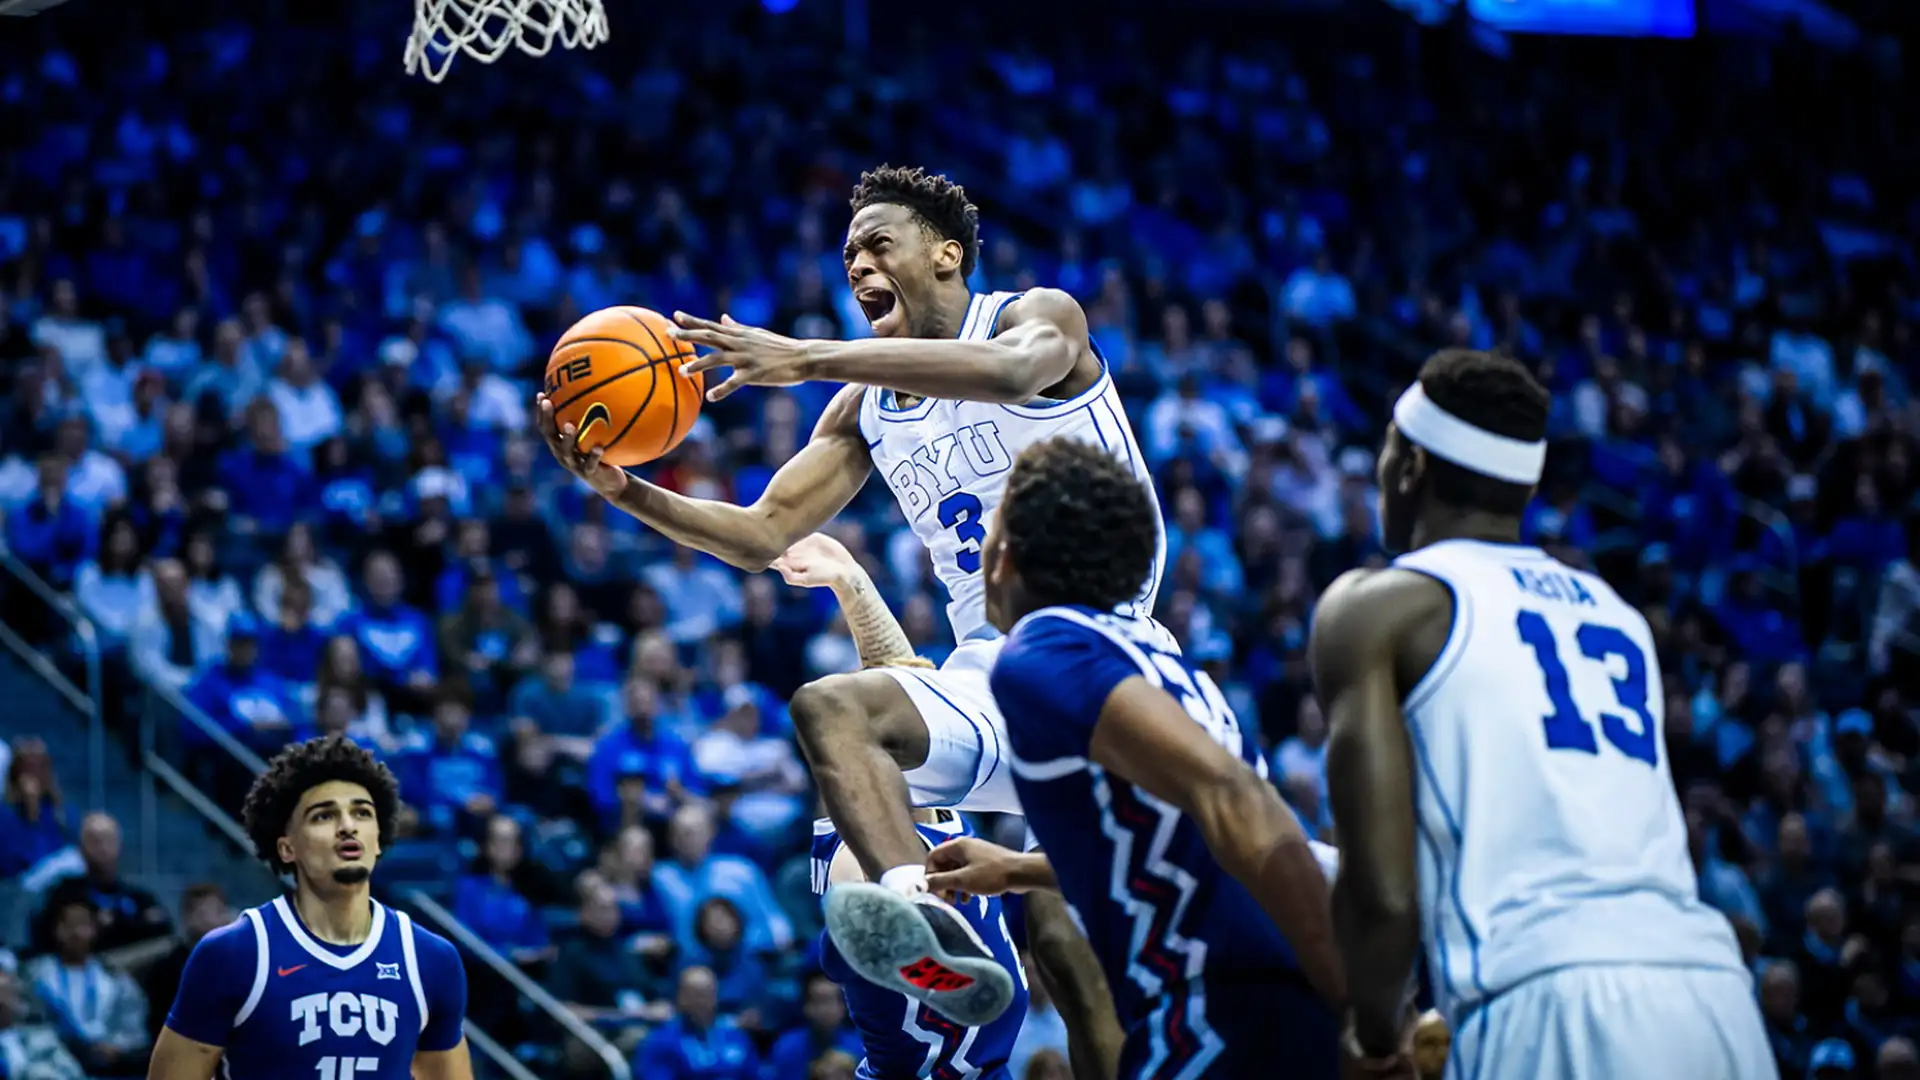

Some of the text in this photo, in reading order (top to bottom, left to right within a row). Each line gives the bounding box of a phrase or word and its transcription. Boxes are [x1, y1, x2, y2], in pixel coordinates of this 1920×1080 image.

[889, 420, 1012, 524] BYU
[937, 491, 987, 574] 3
[1516, 608, 1658, 769] 13
[290, 991, 399, 1047] TCU
